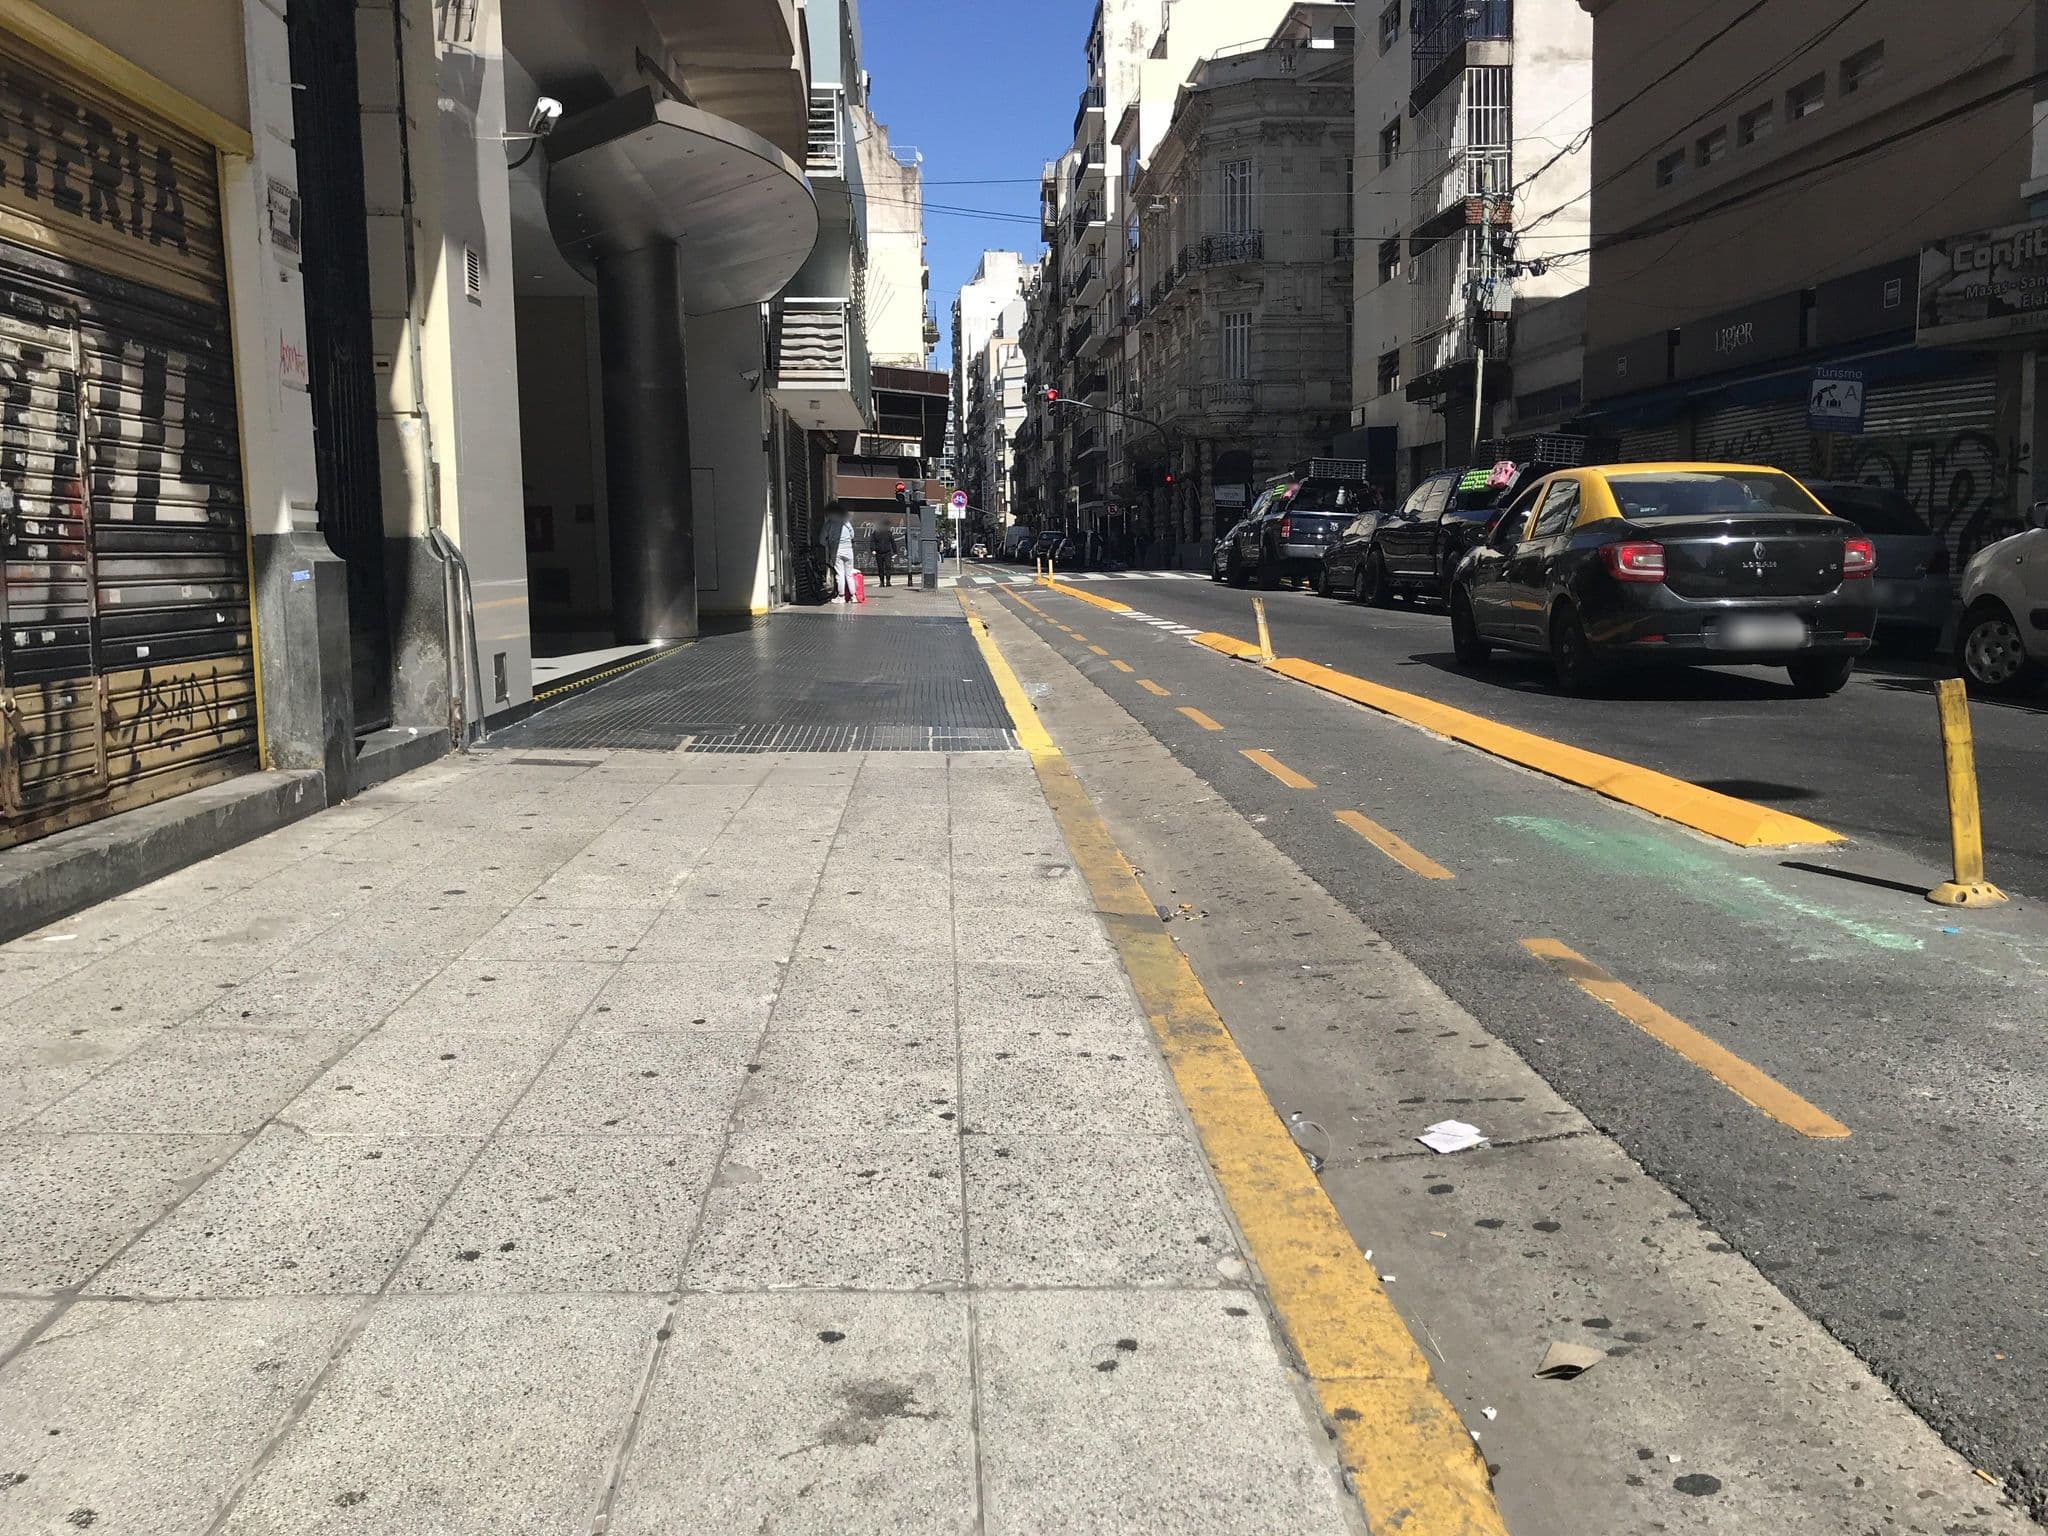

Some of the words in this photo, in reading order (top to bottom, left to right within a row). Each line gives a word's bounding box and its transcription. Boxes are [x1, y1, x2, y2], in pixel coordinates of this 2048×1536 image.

[0, 77, 189, 257] TERIA
[1966, 282, 2008, 299] Masas
[2021, 276, 2048, 289] San
[1816, 367, 1863, 379] Turismo
[1844, 385, 1858, 400] A
